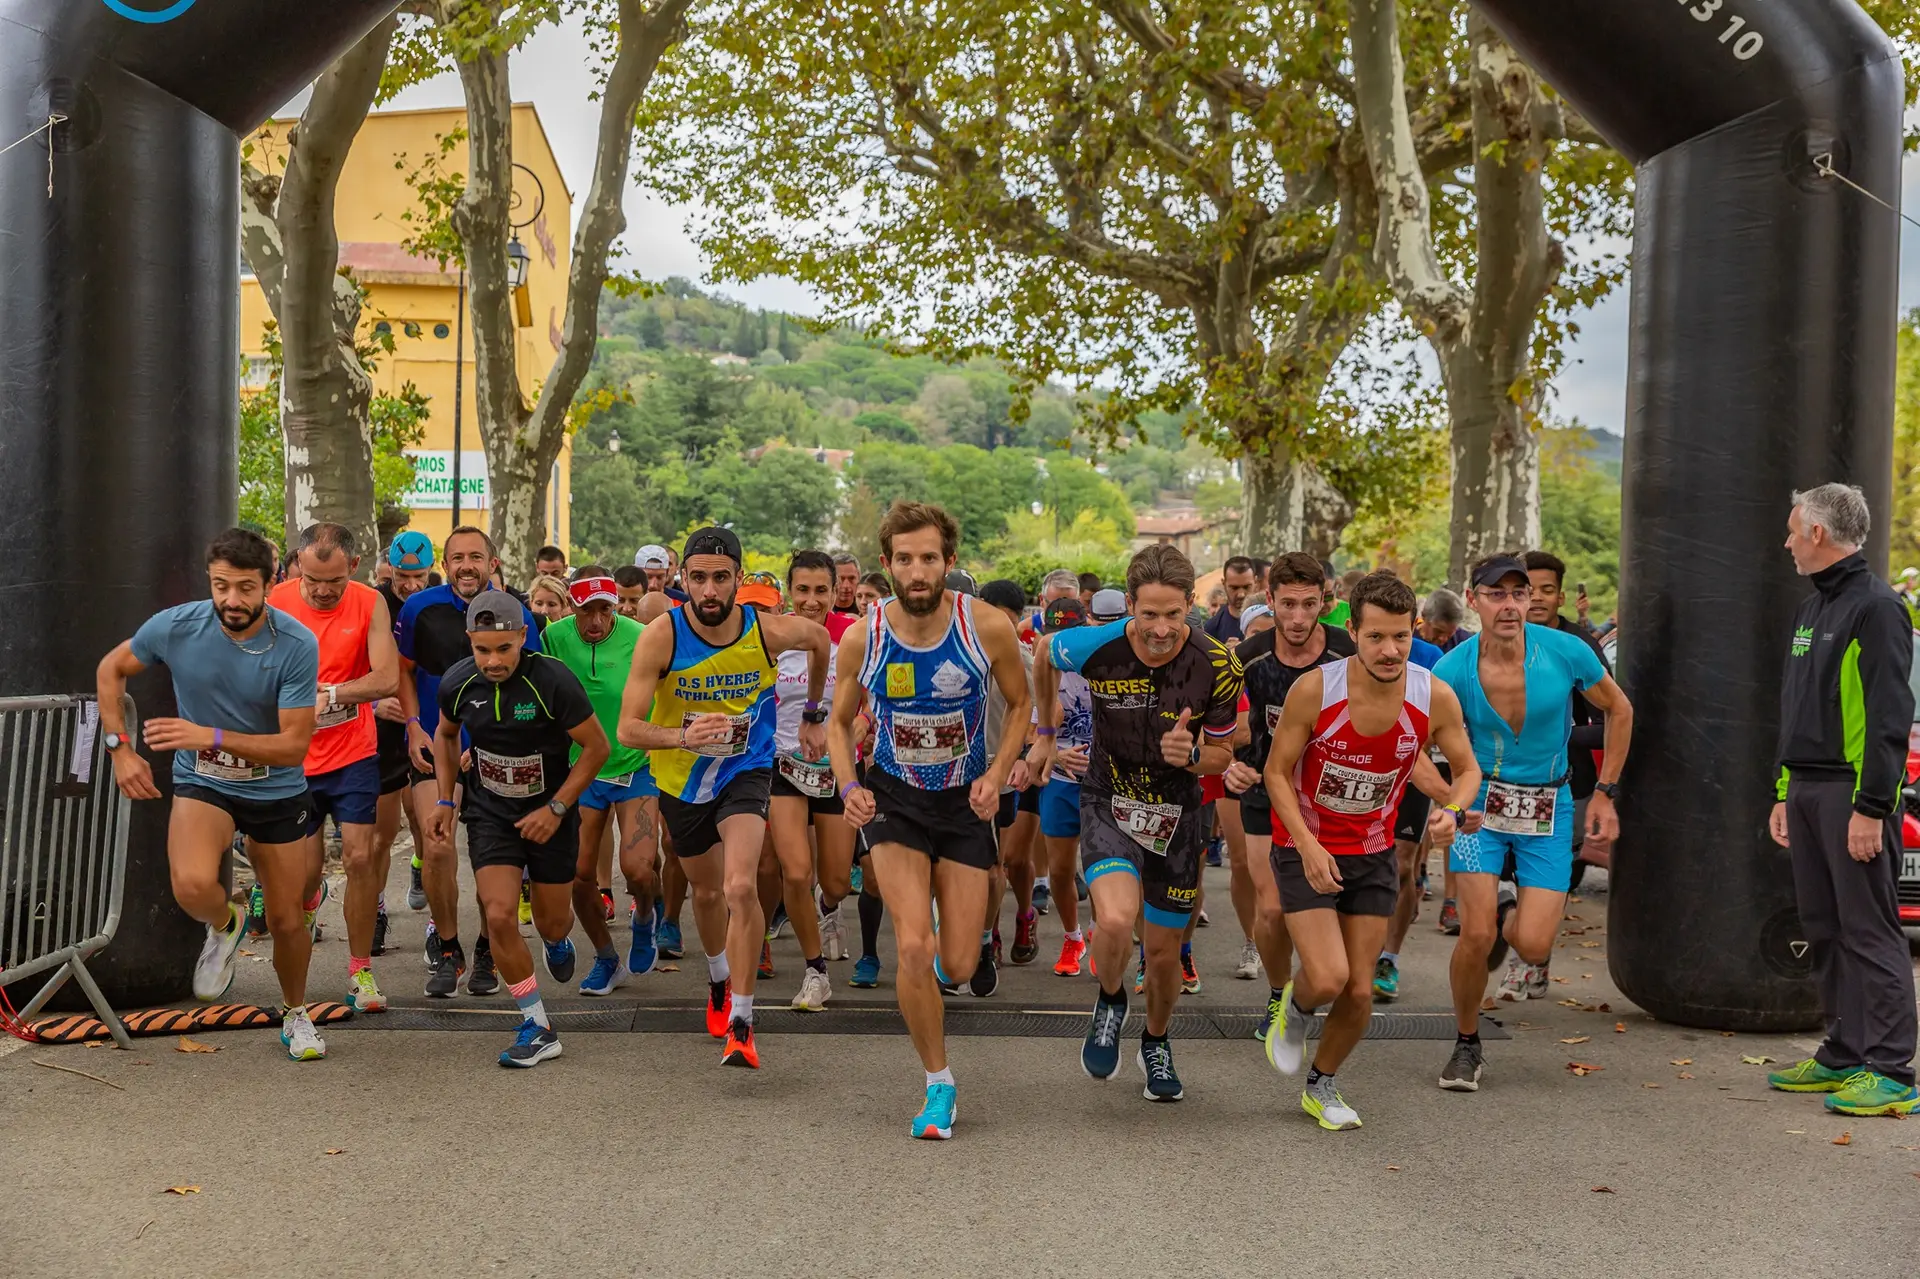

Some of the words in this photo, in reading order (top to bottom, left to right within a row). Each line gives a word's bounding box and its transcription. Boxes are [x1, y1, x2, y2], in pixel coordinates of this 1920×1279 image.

[1718, 15, 1764, 60] 10
[415, 478, 485, 493] CHATAGNE
[678, 677, 700, 689] O.S
[705, 670, 760, 688] HYERES
[1089, 679, 1155, 695] HYERES
[903, 717, 920, 725] course
[921, 718, 929, 726] de
[919, 727, 937, 748] 3
[1330, 751, 1373, 764] GARDE
[502, 767, 514, 784] 1
[1338, 769, 1358, 779] course
[1358, 771, 1366, 780] de
[1367, 773, 1373, 781] la
[1342, 780, 1376, 801] 18
[1503, 796, 1537, 819] 33
[1130, 810, 1162, 835] 64
